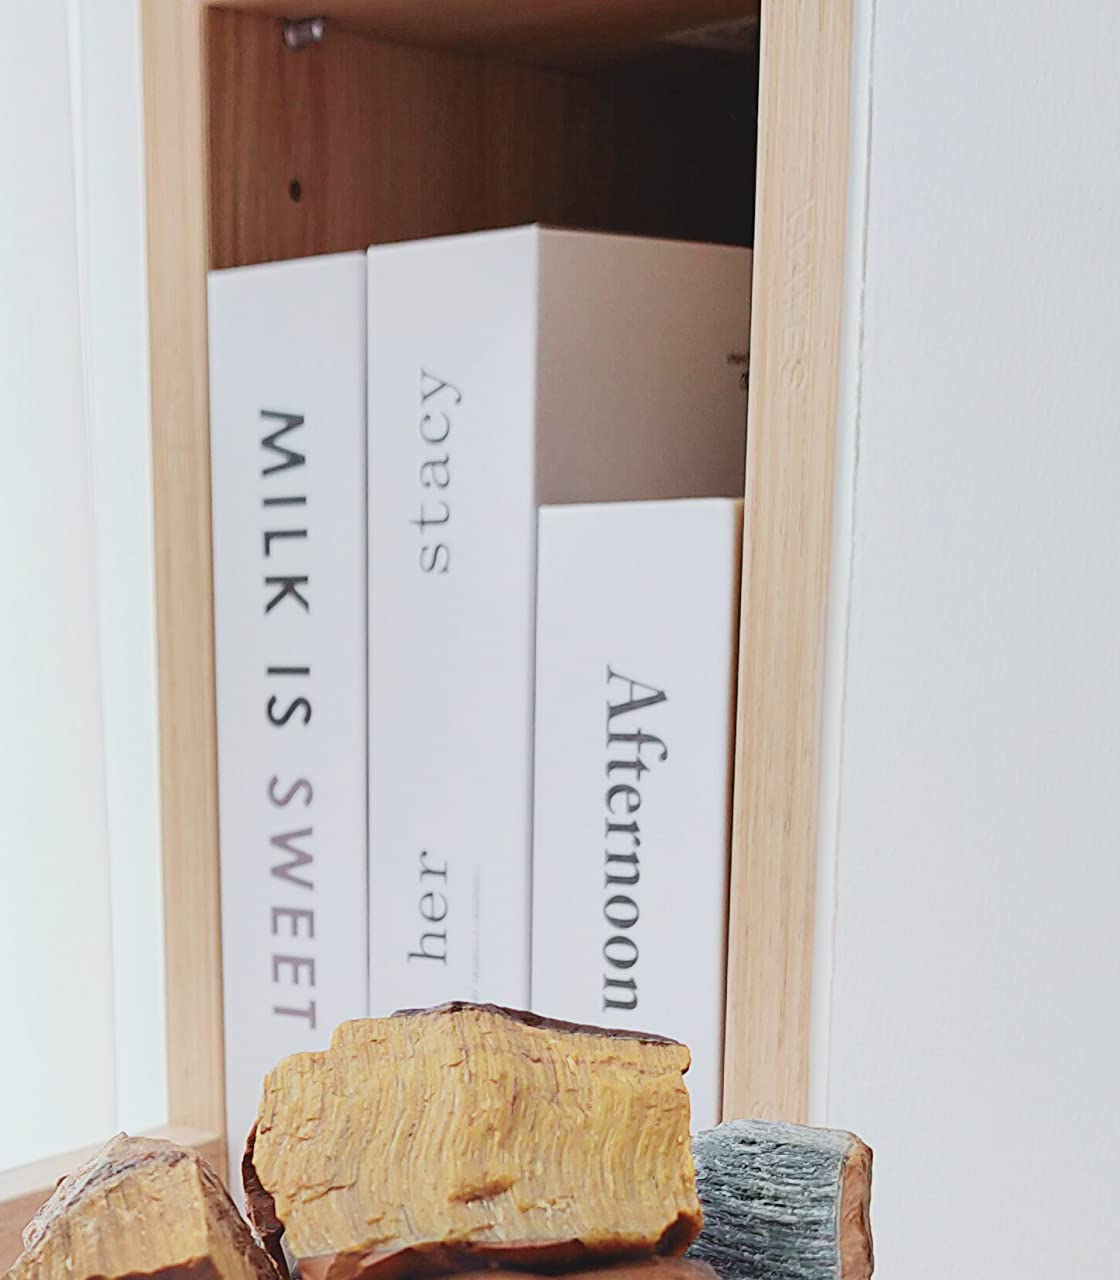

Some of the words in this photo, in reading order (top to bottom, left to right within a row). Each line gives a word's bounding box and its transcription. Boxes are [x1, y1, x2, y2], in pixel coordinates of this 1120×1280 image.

[259, 408, 310, 615] MILK
[410, 368, 462, 575] stacy
[265, 665, 312, 728] IS
[267, 775, 316, 1030] SWEET
[407, 849, 448, 966] her
[602, 664, 668, 1013] Afternoon
